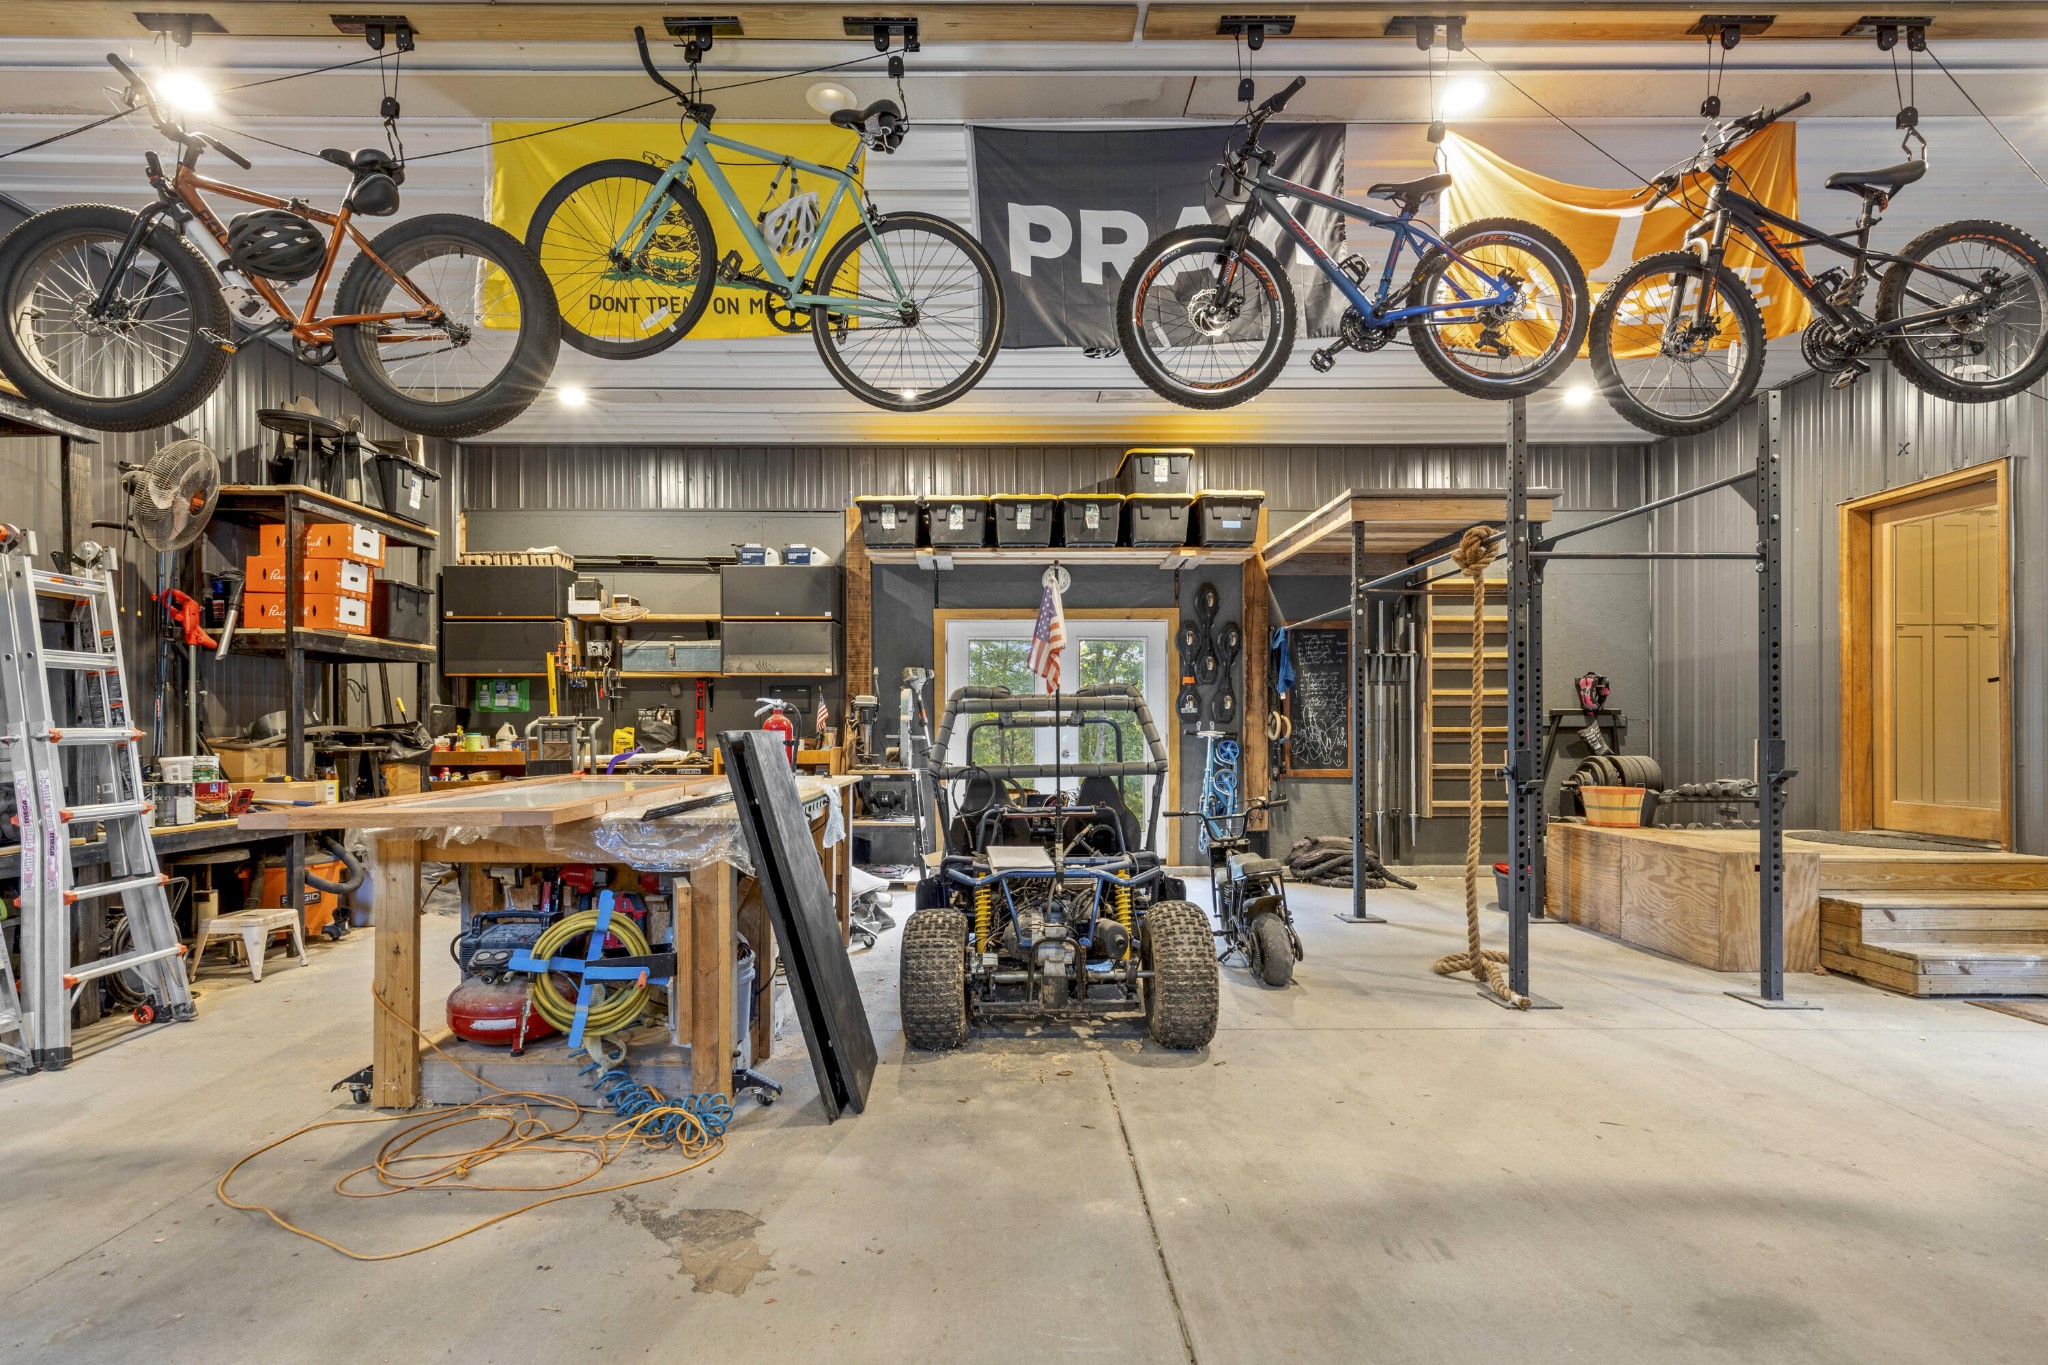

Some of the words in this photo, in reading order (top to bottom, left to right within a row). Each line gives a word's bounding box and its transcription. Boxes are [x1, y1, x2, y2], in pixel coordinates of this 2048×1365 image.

[588, 293, 641, 314] DONT
[645, 296, 691, 314] TRE
[713, 297, 739, 315] ON
